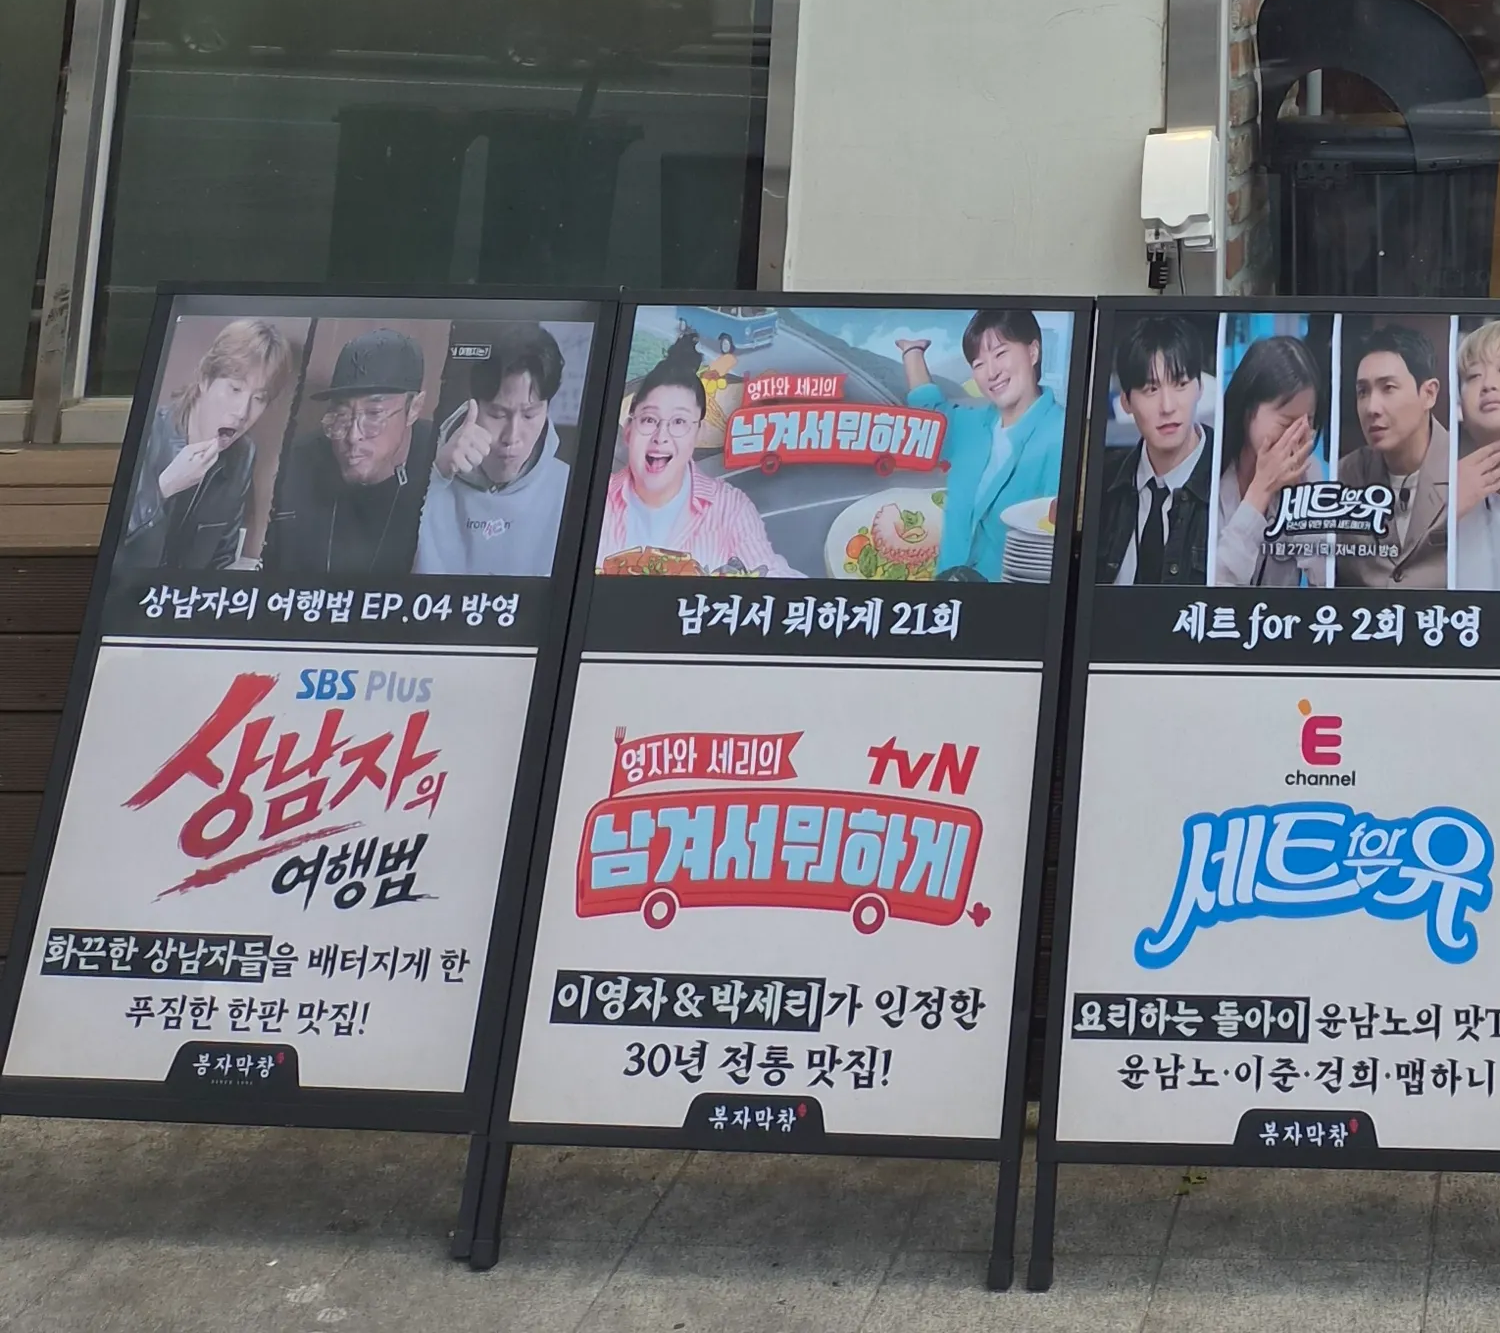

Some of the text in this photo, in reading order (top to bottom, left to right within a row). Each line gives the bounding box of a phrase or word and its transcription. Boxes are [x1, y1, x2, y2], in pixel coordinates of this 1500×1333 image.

[745, 375, 838, 401] 영자와 세리의
[1262, 543, 1287, 556] 11월
[1287, 543, 1313, 556] 27일
[1336, 543, 1357, 556] 저녁
[1358, 545, 1376, 556] 8시
[1378, 544, 1399, 557] 방송
[139, 586, 520, 628] 상남자의 여행법 EP.04 방영
[676, 593, 962, 642] 남겨서 뭐하게 21회
[1172, 602, 1482, 650] 세트 for 유 2회 방영
[296, 667, 434, 703] SBS Plus
[120, 672, 448, 860] 상남자의
[620, 735, 783, 783] 영자와 세리의
[866, 735, 980, 796] tvN
[1284, 769, 1356, 788] channel
[271, 833, 440, 912] 여행법
[44, 933, 471, 983] 화끈한 상남자들을 배터지게 한
[124, 995, 372, 1037] 푸짐한 한판 맛집!
[876, 985, 986, 1032] 인정한
[1074, 996, 1205, 1039] 요리하는
[1211, 999, 1308, 1041] 돌아이
[1315, 1002, 1441, 1042] 윤남노의
[192, 1052, 275, 1078] 봉자막창
[623, 1040, 894, 1090] 30년 전통 맛집!
[708, 1104, 797, 1133] 봉자막창
[1258, 1120, 1349, 1149] 봉자막창
